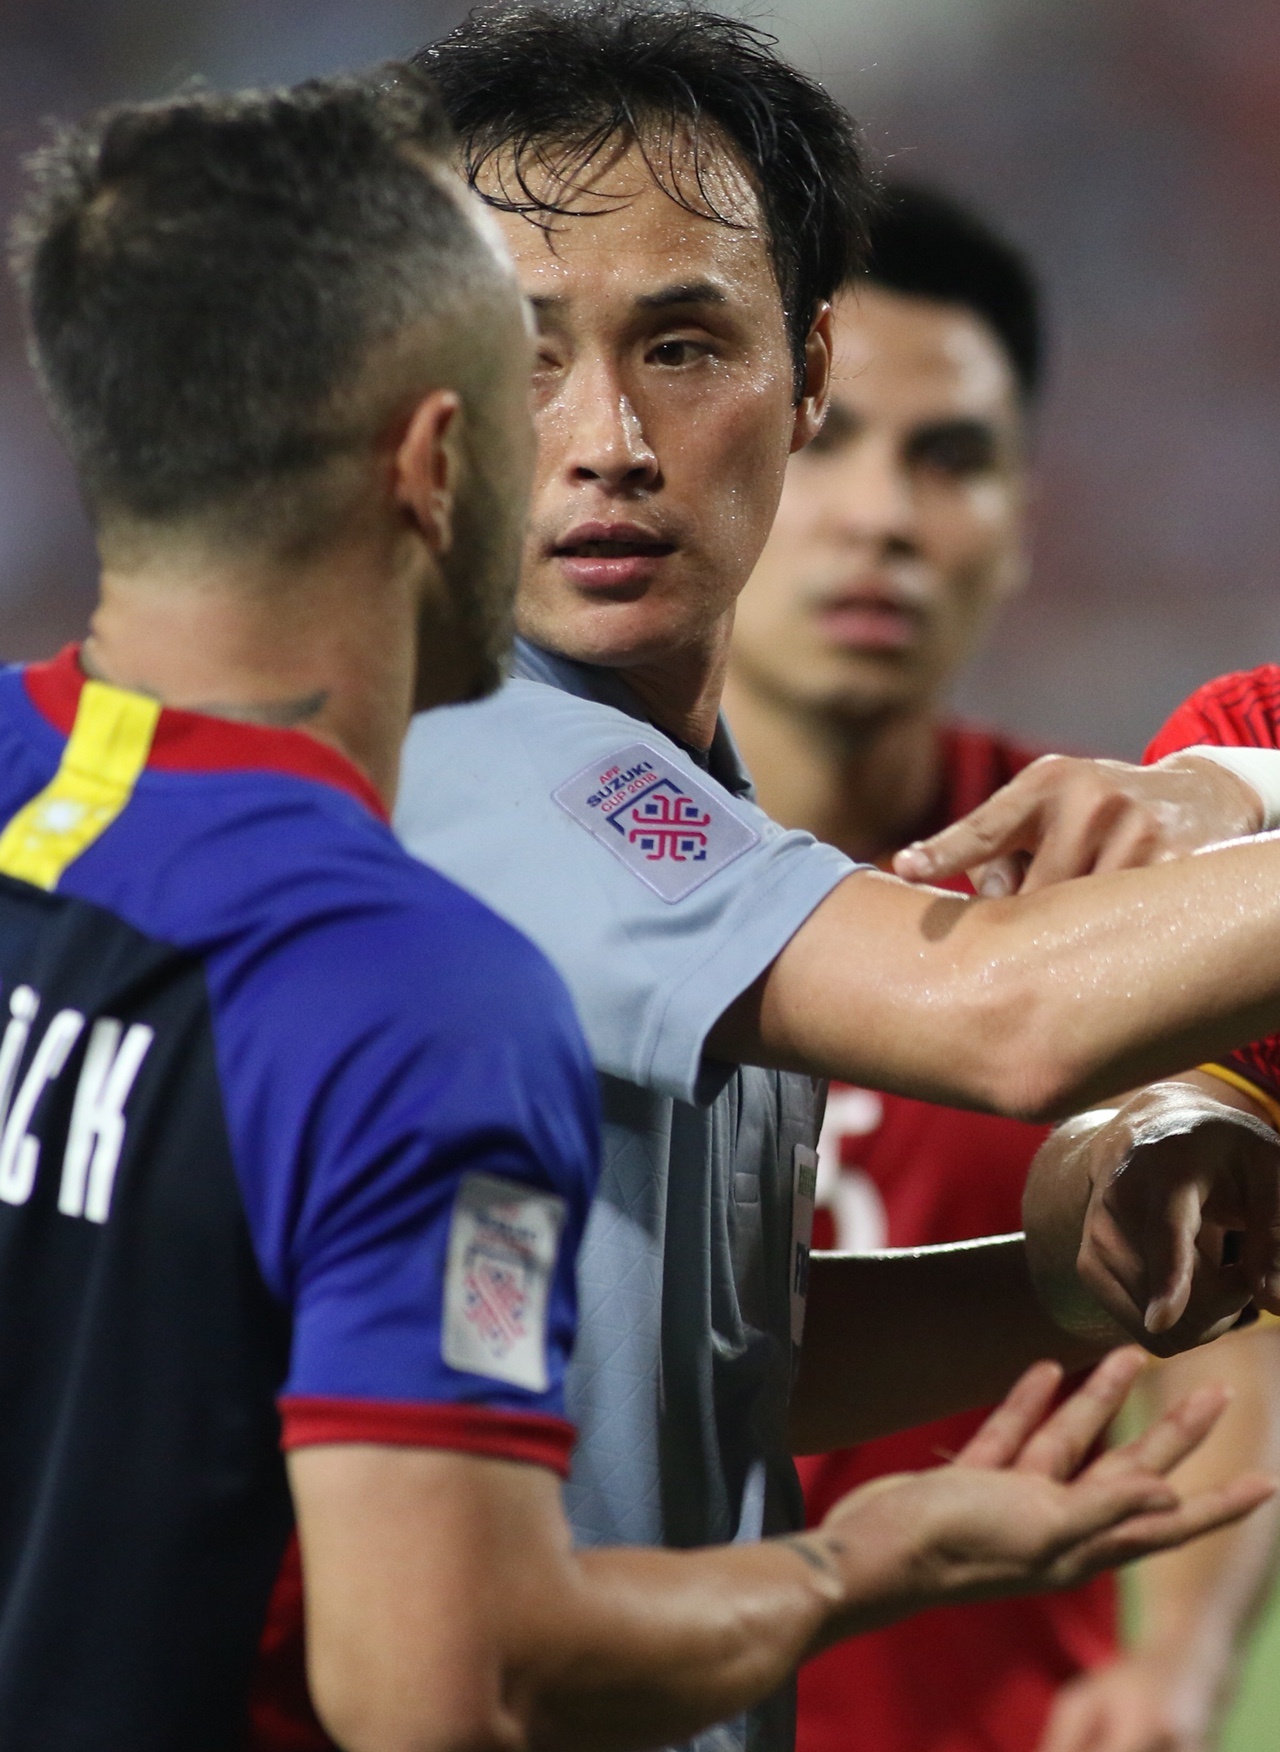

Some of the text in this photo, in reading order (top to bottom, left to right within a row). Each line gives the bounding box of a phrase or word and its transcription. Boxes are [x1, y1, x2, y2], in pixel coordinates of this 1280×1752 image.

[587, 762, 653, 807] SUZUKI
[600, 766, 620, 784] AFF
[601, 773, 657, 812] CUP 2018
